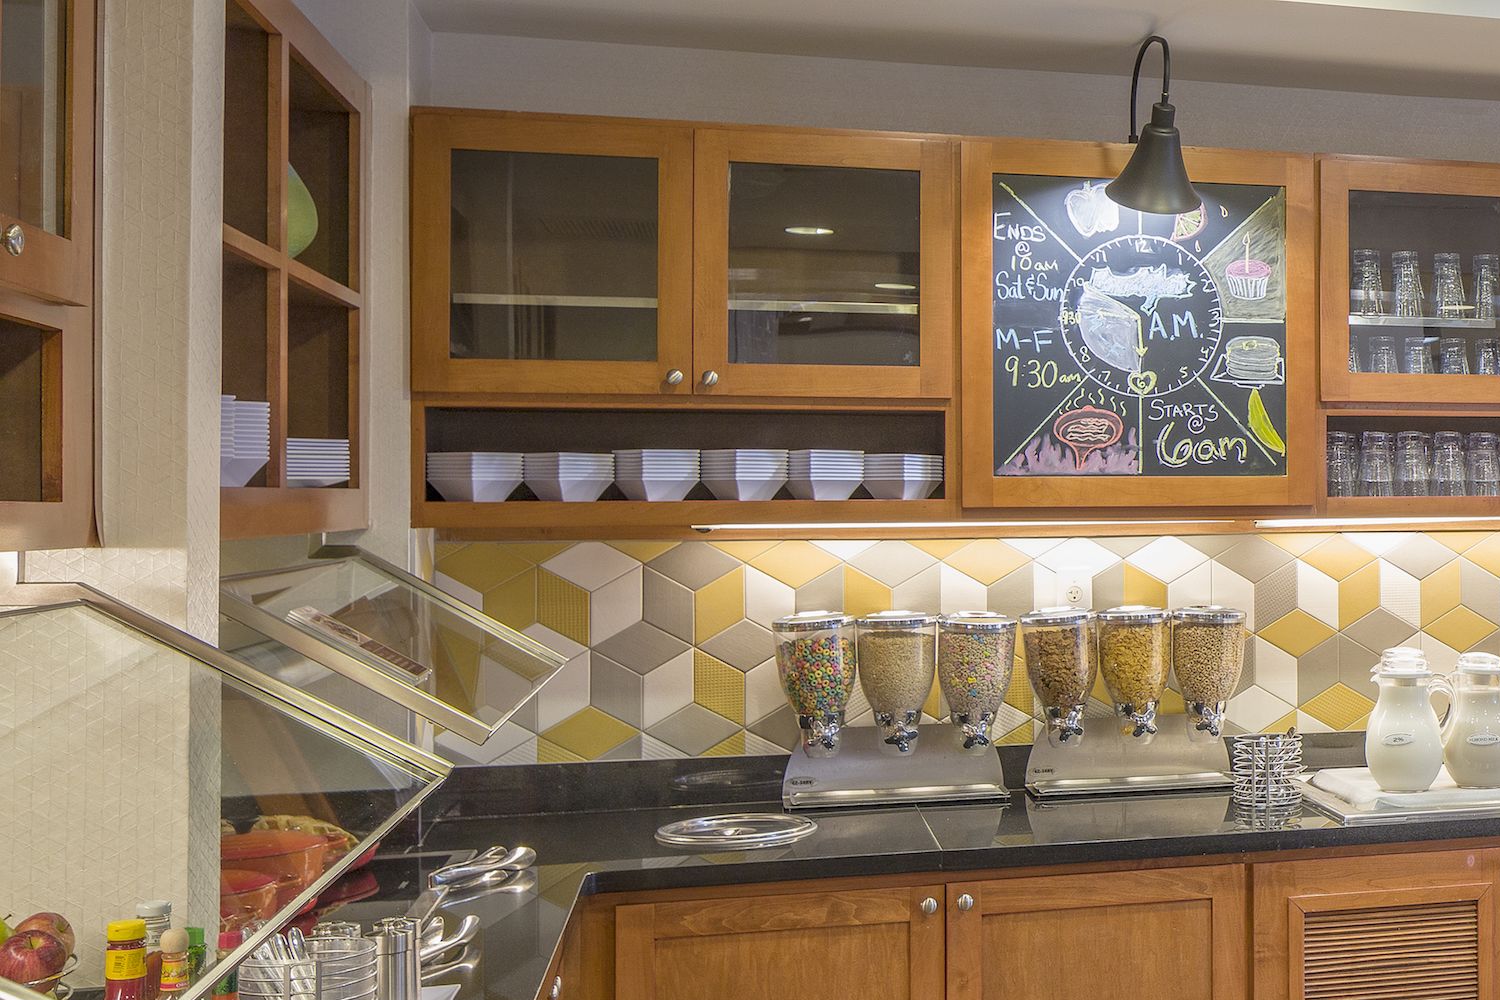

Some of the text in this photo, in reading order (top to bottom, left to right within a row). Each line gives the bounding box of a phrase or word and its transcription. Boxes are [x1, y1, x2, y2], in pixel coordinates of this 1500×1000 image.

[994, 212, 1046, 242] ENDS
[1015, 241, 1032, 257] @
[1135, 240, 1152, 253] 12
[1096, 250, 1108, 262] 11
[1200, 279, 1214, 292] 2
[1208, 311, 1220, 328] 3
[996, 328, 1054, 353] M-F
[1080, 346, 1091, 363] 8
[1179, 366, 1188, 378] 5
[1136, 378, 1146, 388] 6
[1148, 398, 1219, 422] STARTS
[1187, 414, 1206, 434] @
